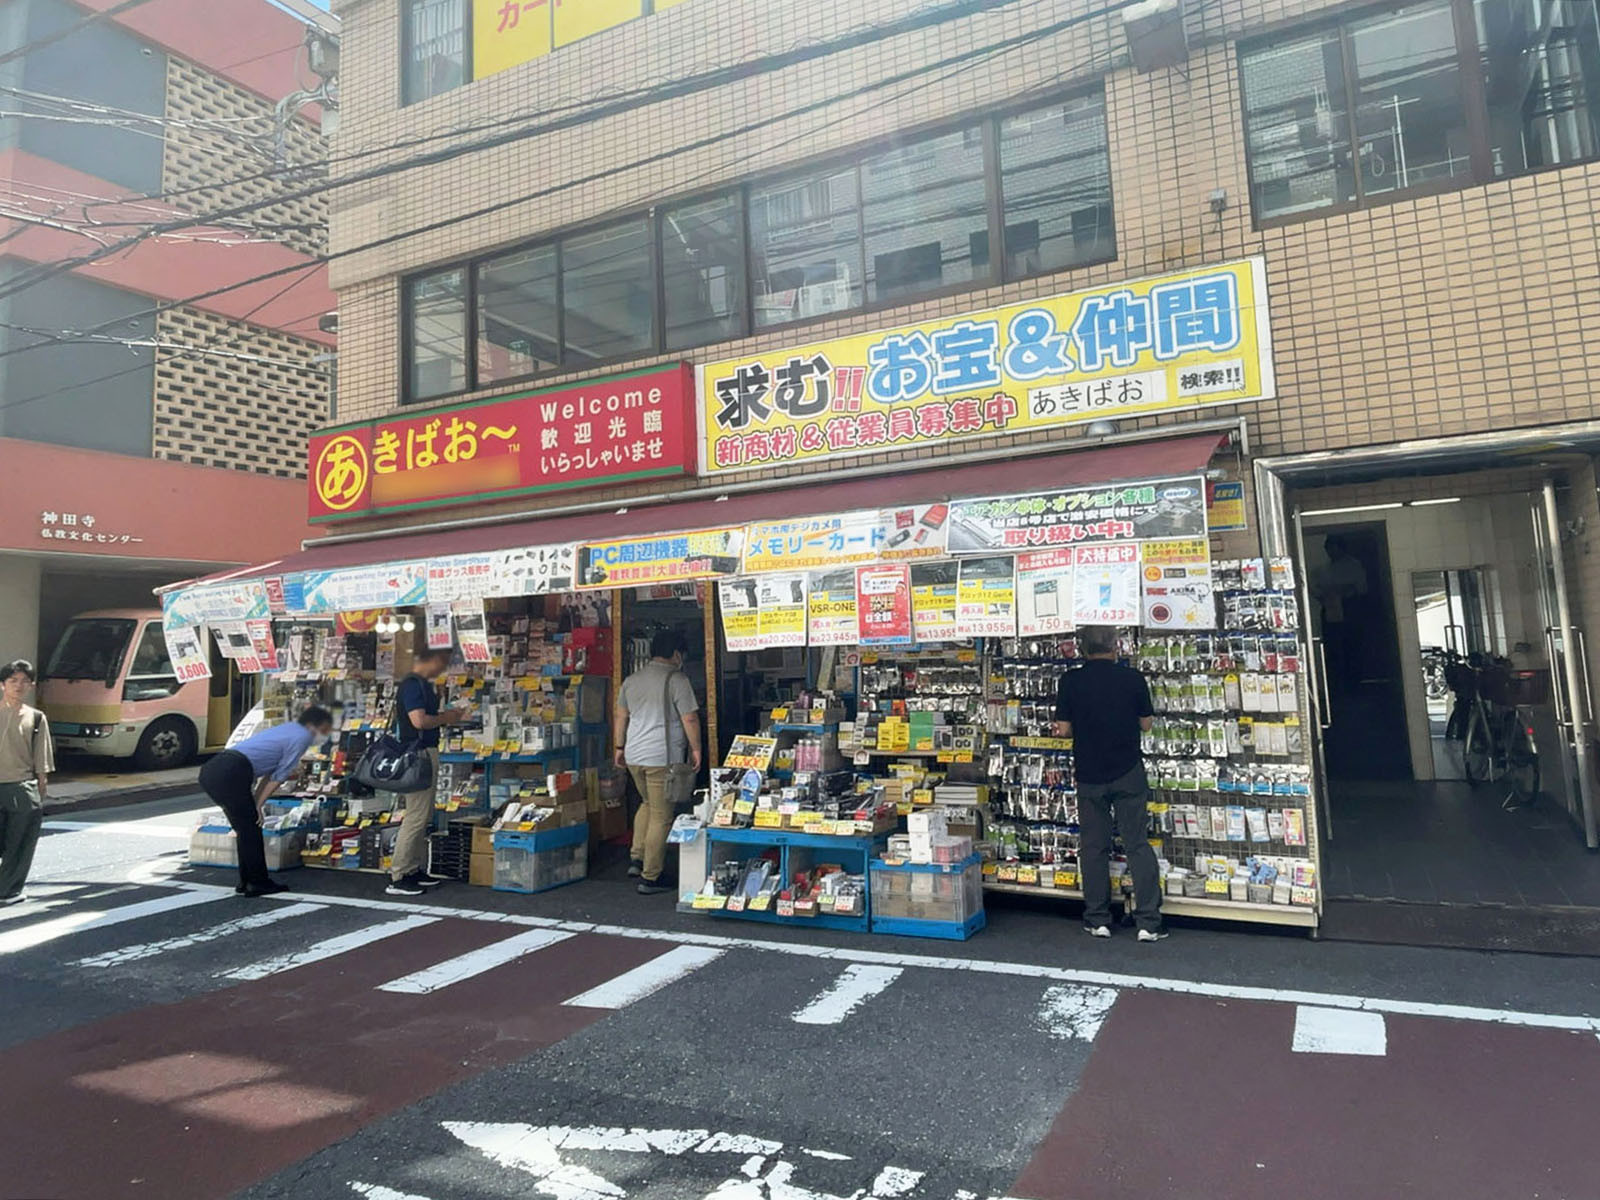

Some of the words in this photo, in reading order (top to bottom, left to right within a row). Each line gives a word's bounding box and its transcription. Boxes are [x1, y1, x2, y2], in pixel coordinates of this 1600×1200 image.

[540, 387, 663, 423] Welcome
[1032, 377, 1145, 417] あきばお
[715, 394, 1019, 467] 新商材&従業員募集中
[540, 437, 664, 475] いらっしゃいませ
[41, 511, 96, 528] 神田寺
[41, 528, 144, 544] 仏教文化センター
[749, 526, 887, 557] メモリーカード
[590, 538, 689, 566] PC周辺機器
[809, 601, 856, 614] VSR-ONE
